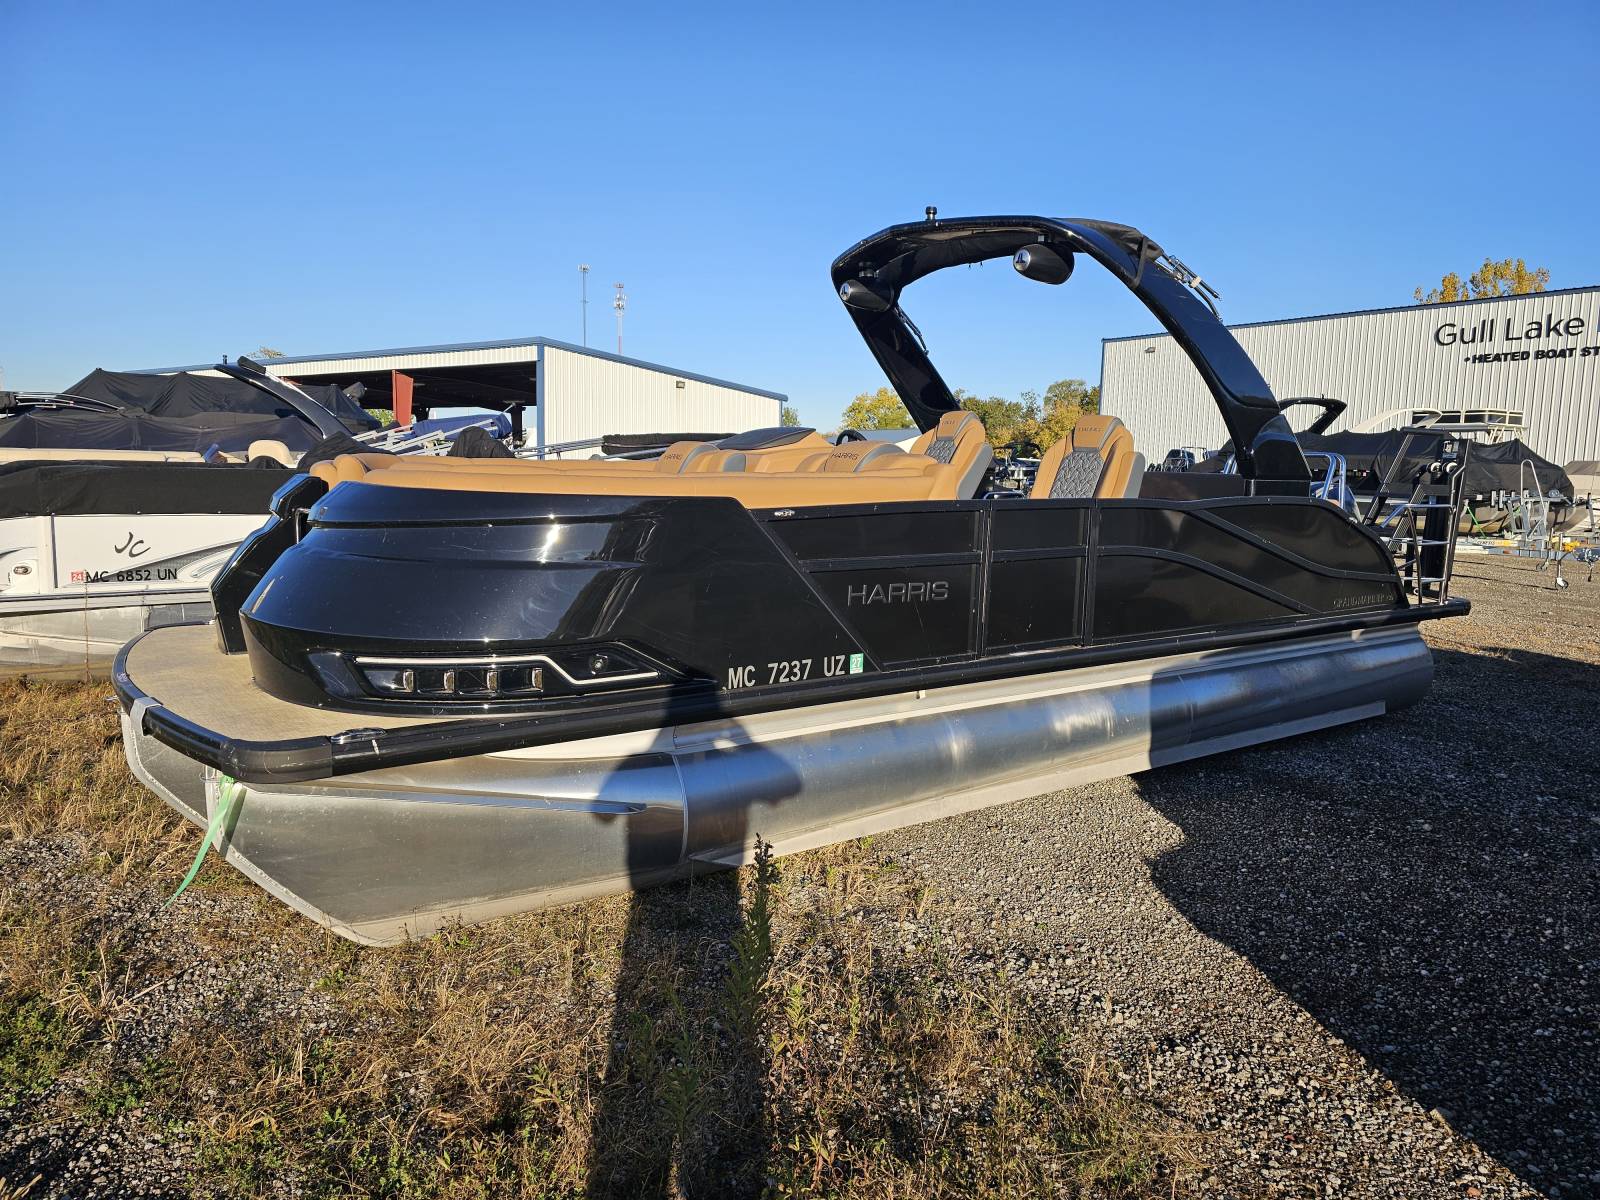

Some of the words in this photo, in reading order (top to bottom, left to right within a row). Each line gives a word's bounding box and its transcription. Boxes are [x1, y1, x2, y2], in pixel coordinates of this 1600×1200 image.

[1434, 318, 1495, 346] Gull
[1504, 313, 1585, 342] Lake
[1472, 351, 1531, 364] HEATED
[1534, 348, 1577, 360] BOAT
[114, 532, 151, 558] JC
[86, 571, 109, 583] MC
[117, 570, 151, 581] 6852
[157, 568, 178, 580] UN
[847, 581, 949, 606] HARRIS
[728, 665, 756, 689] MC
[767, 659, 812, 684] 7237
[823, 655, 846, 677] UZ
